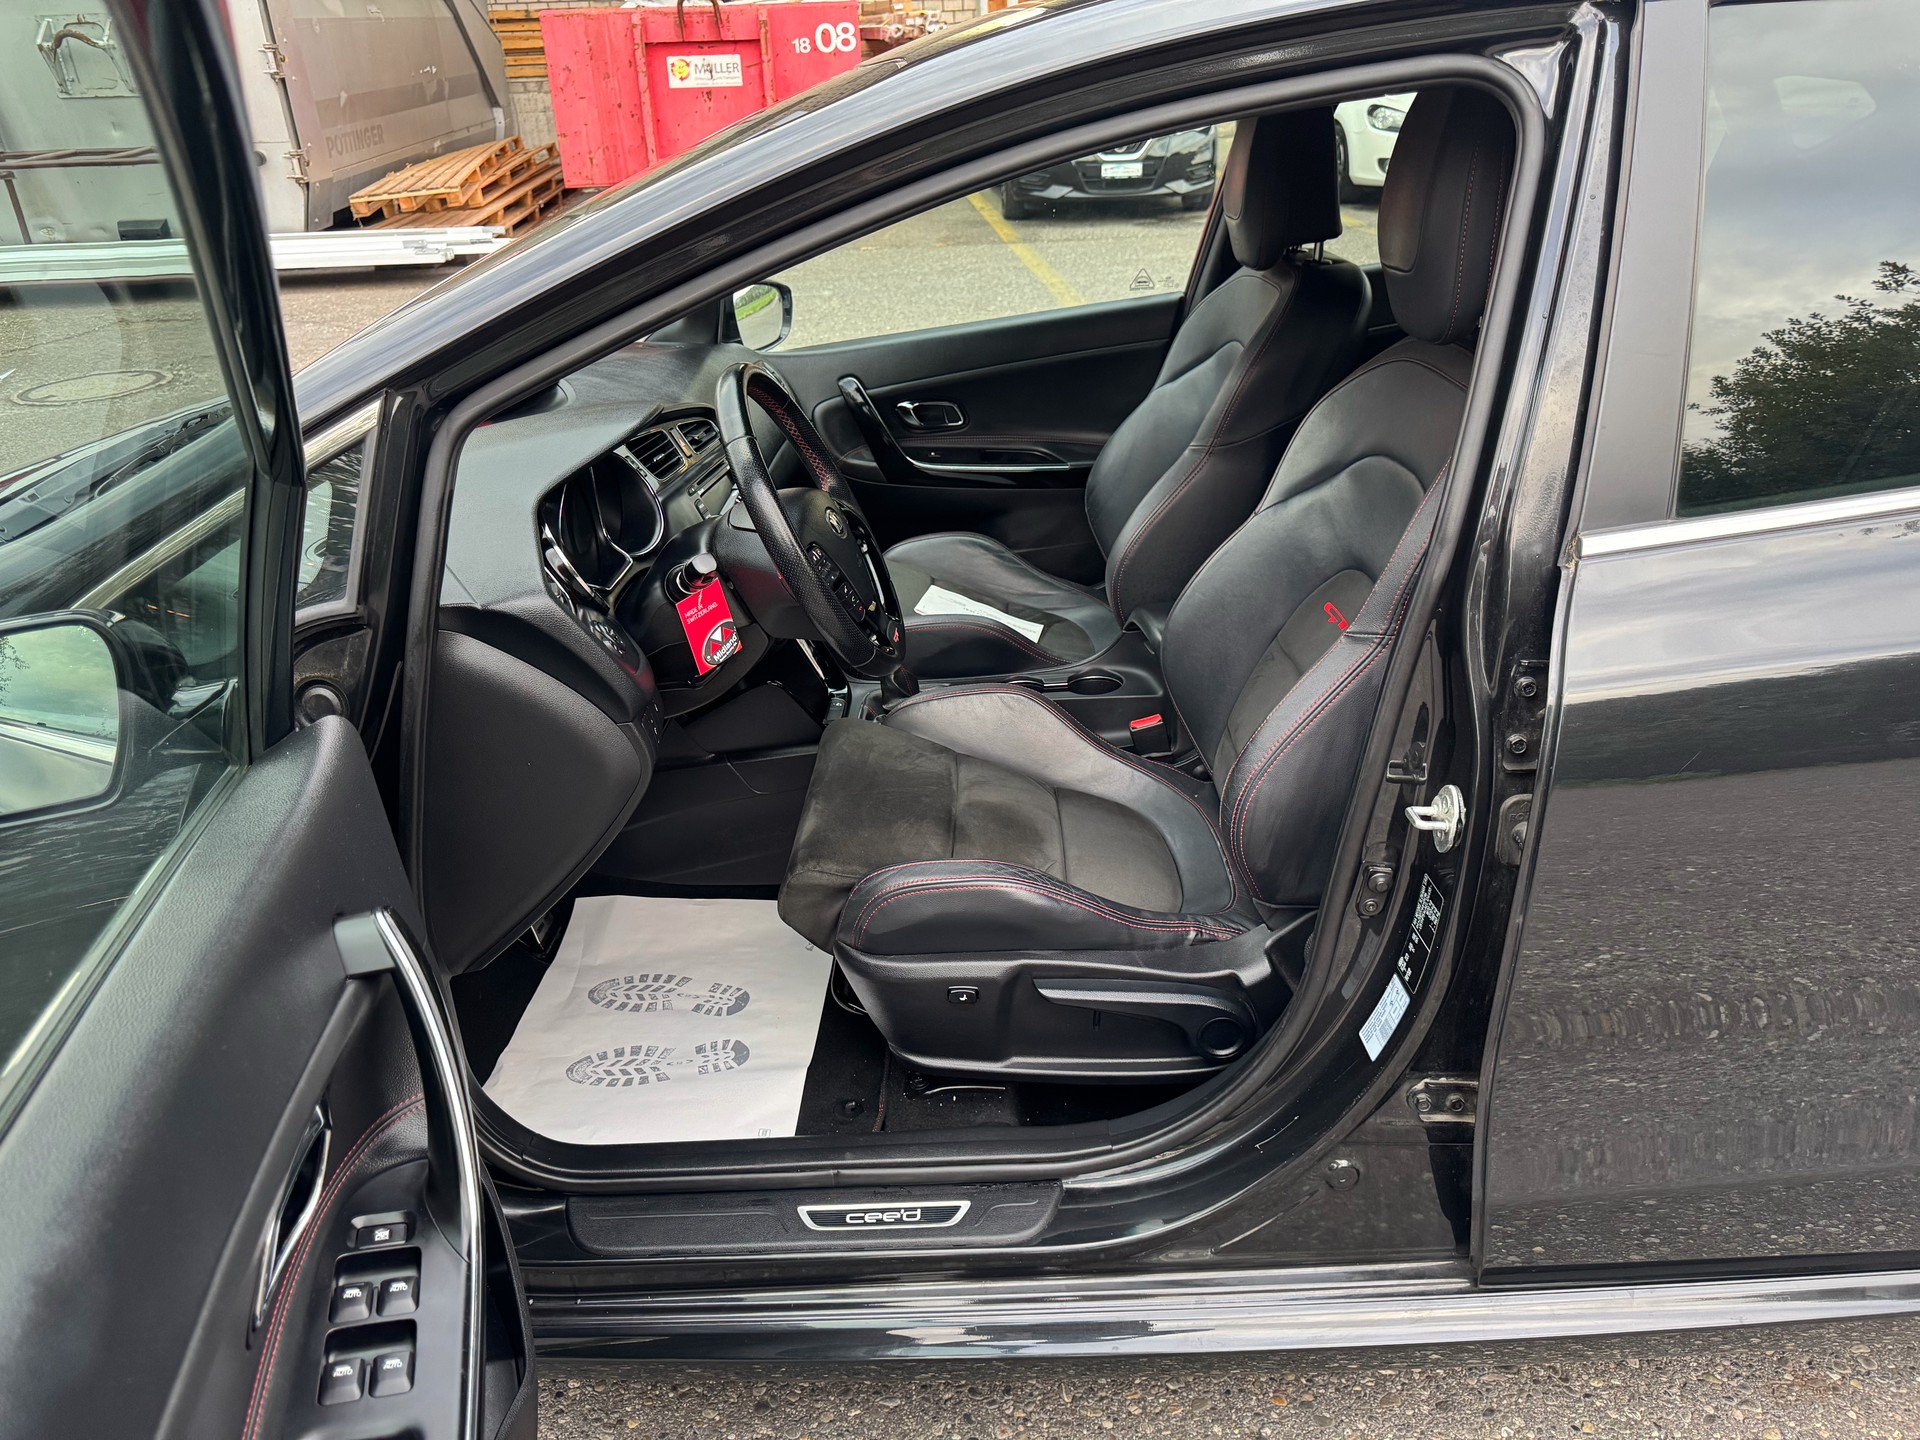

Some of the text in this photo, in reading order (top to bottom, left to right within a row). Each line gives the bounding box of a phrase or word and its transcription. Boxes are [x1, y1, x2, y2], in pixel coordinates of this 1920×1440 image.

[792, 22, 857, 54] 18 08
[713, 631, 738, 662] Midland
[845, 1208, 922, 1224] cee'd
